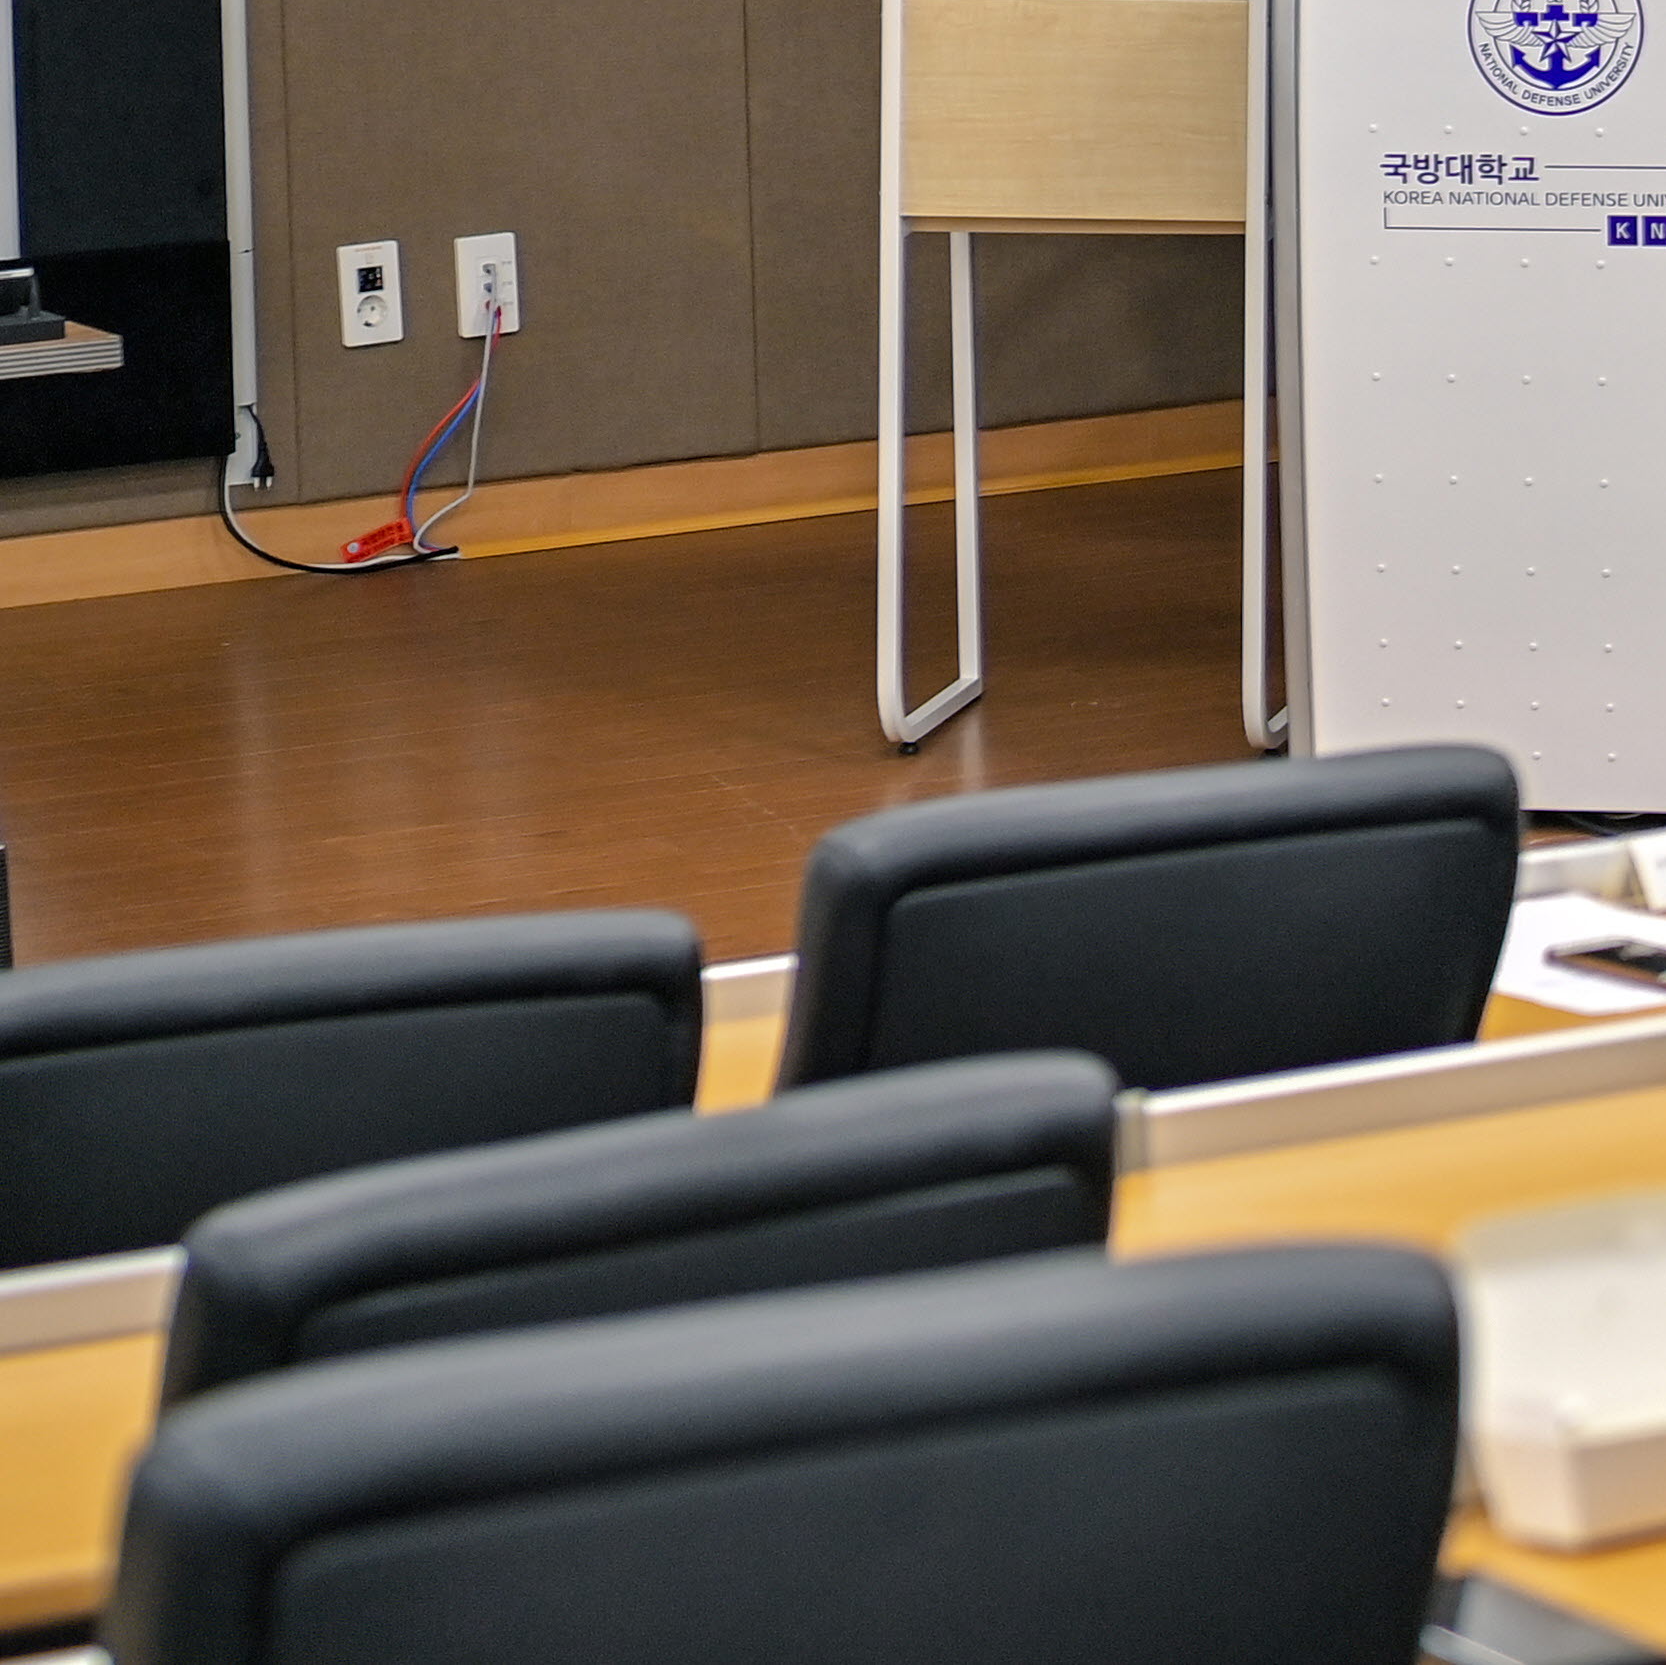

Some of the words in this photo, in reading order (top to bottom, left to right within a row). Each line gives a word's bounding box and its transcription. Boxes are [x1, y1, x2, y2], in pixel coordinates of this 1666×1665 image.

[1478, 42, 1519, 96] NATIONAL
[1520, 88, 1581, 107] DEFENSE
[1583, 41, 1635, 101] UNIVERSITY
[1379, 153, 1540, 185] 국방대학교
[1383, 190, 1445, 205] KOREA
[1448, 191, 1540, 207] NATIONAL
[1545, 192, 1629, 208] DEFENSE
